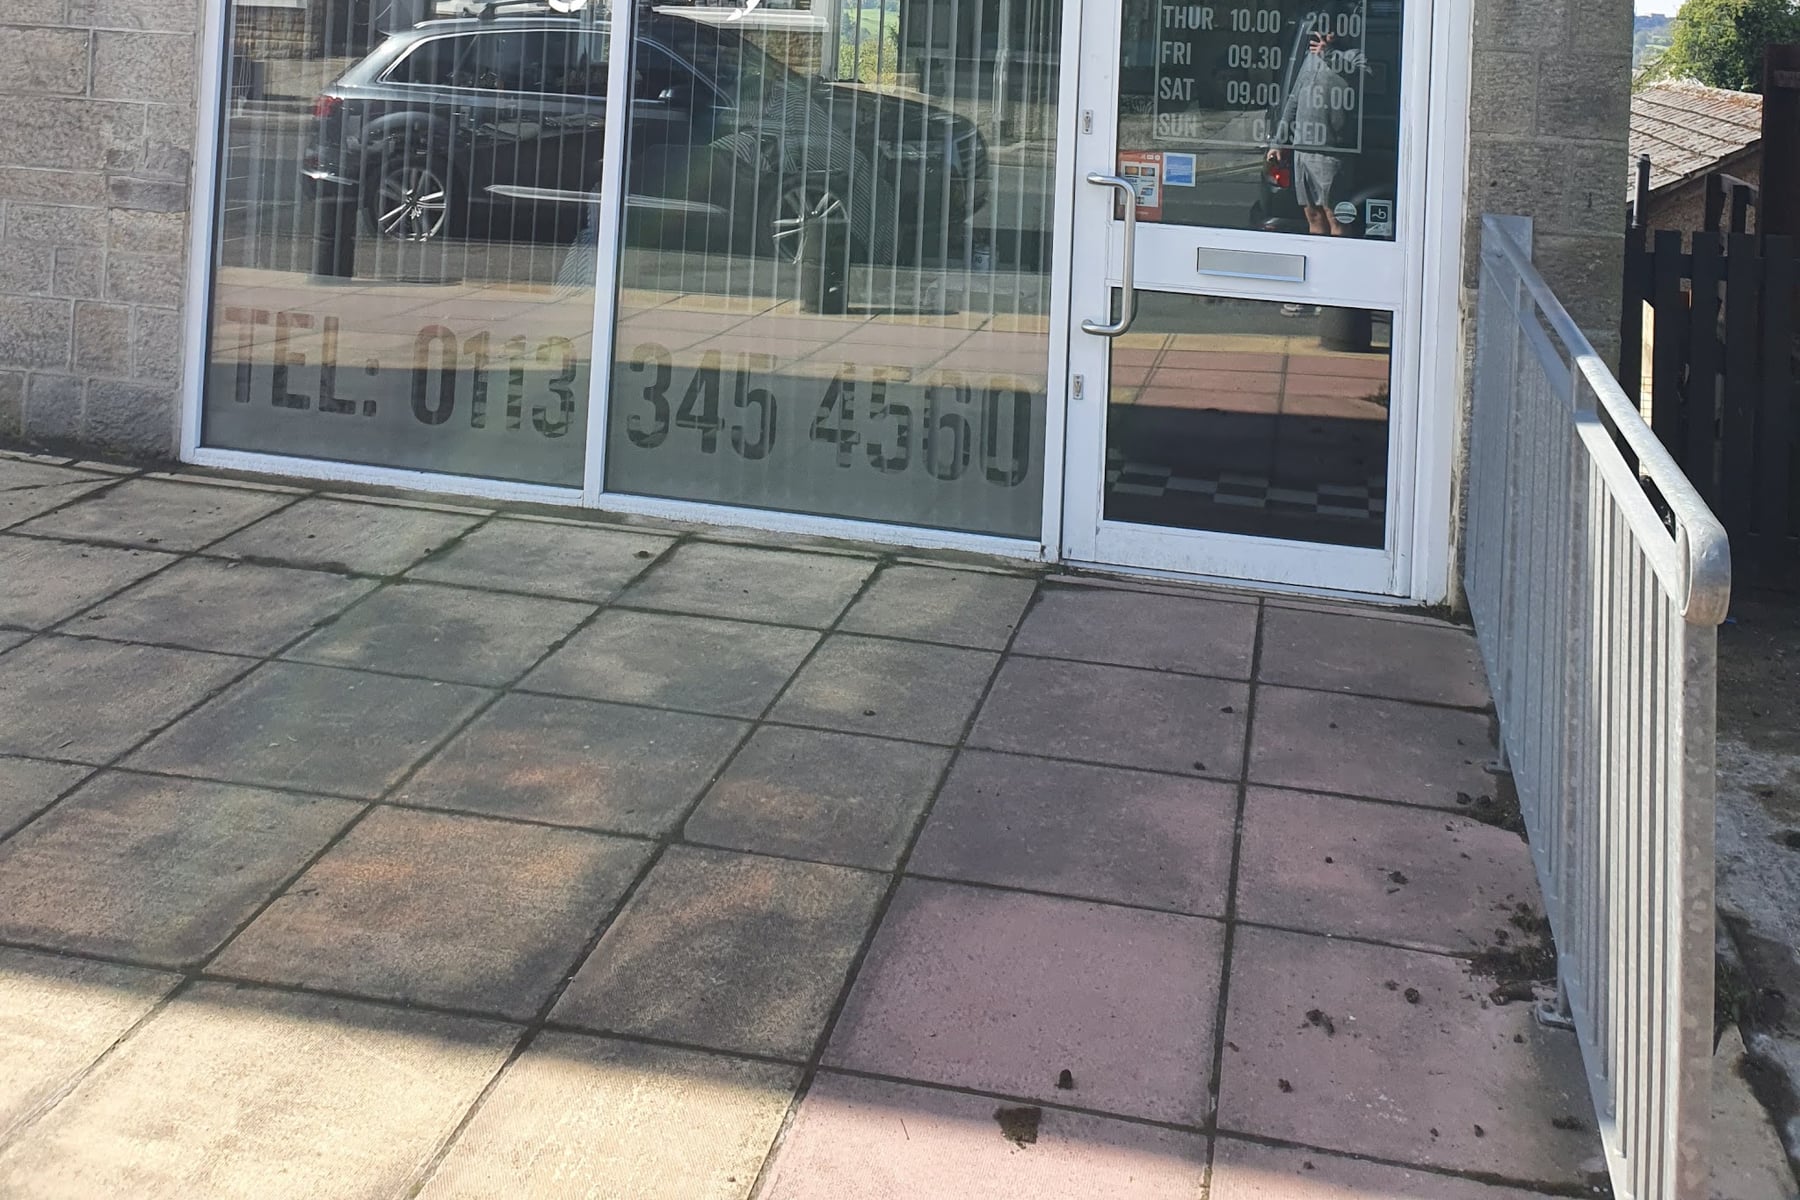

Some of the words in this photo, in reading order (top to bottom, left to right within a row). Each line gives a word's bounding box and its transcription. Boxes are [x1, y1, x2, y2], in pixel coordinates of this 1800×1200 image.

[1163, 5, 1214, 30] THUR
[1230, 8, 1281, 34] 10.00
[1161, 41, 1191, 65] FRI
[1228, 44, 1282, 70] 09.30
[1160, 77, 1195, 101] SAT
[1227, 80, 1280, 106] 09.00
[1303, 85, 1355, 111] 16.00
[1159, 113, 1198, 138] SUN
[225, 307, 380, 418] TEL:
[410, 324, 578, 439] 0113
[626, 342, 778, 460] 345
[809, 361, 1032, 488] 4560
